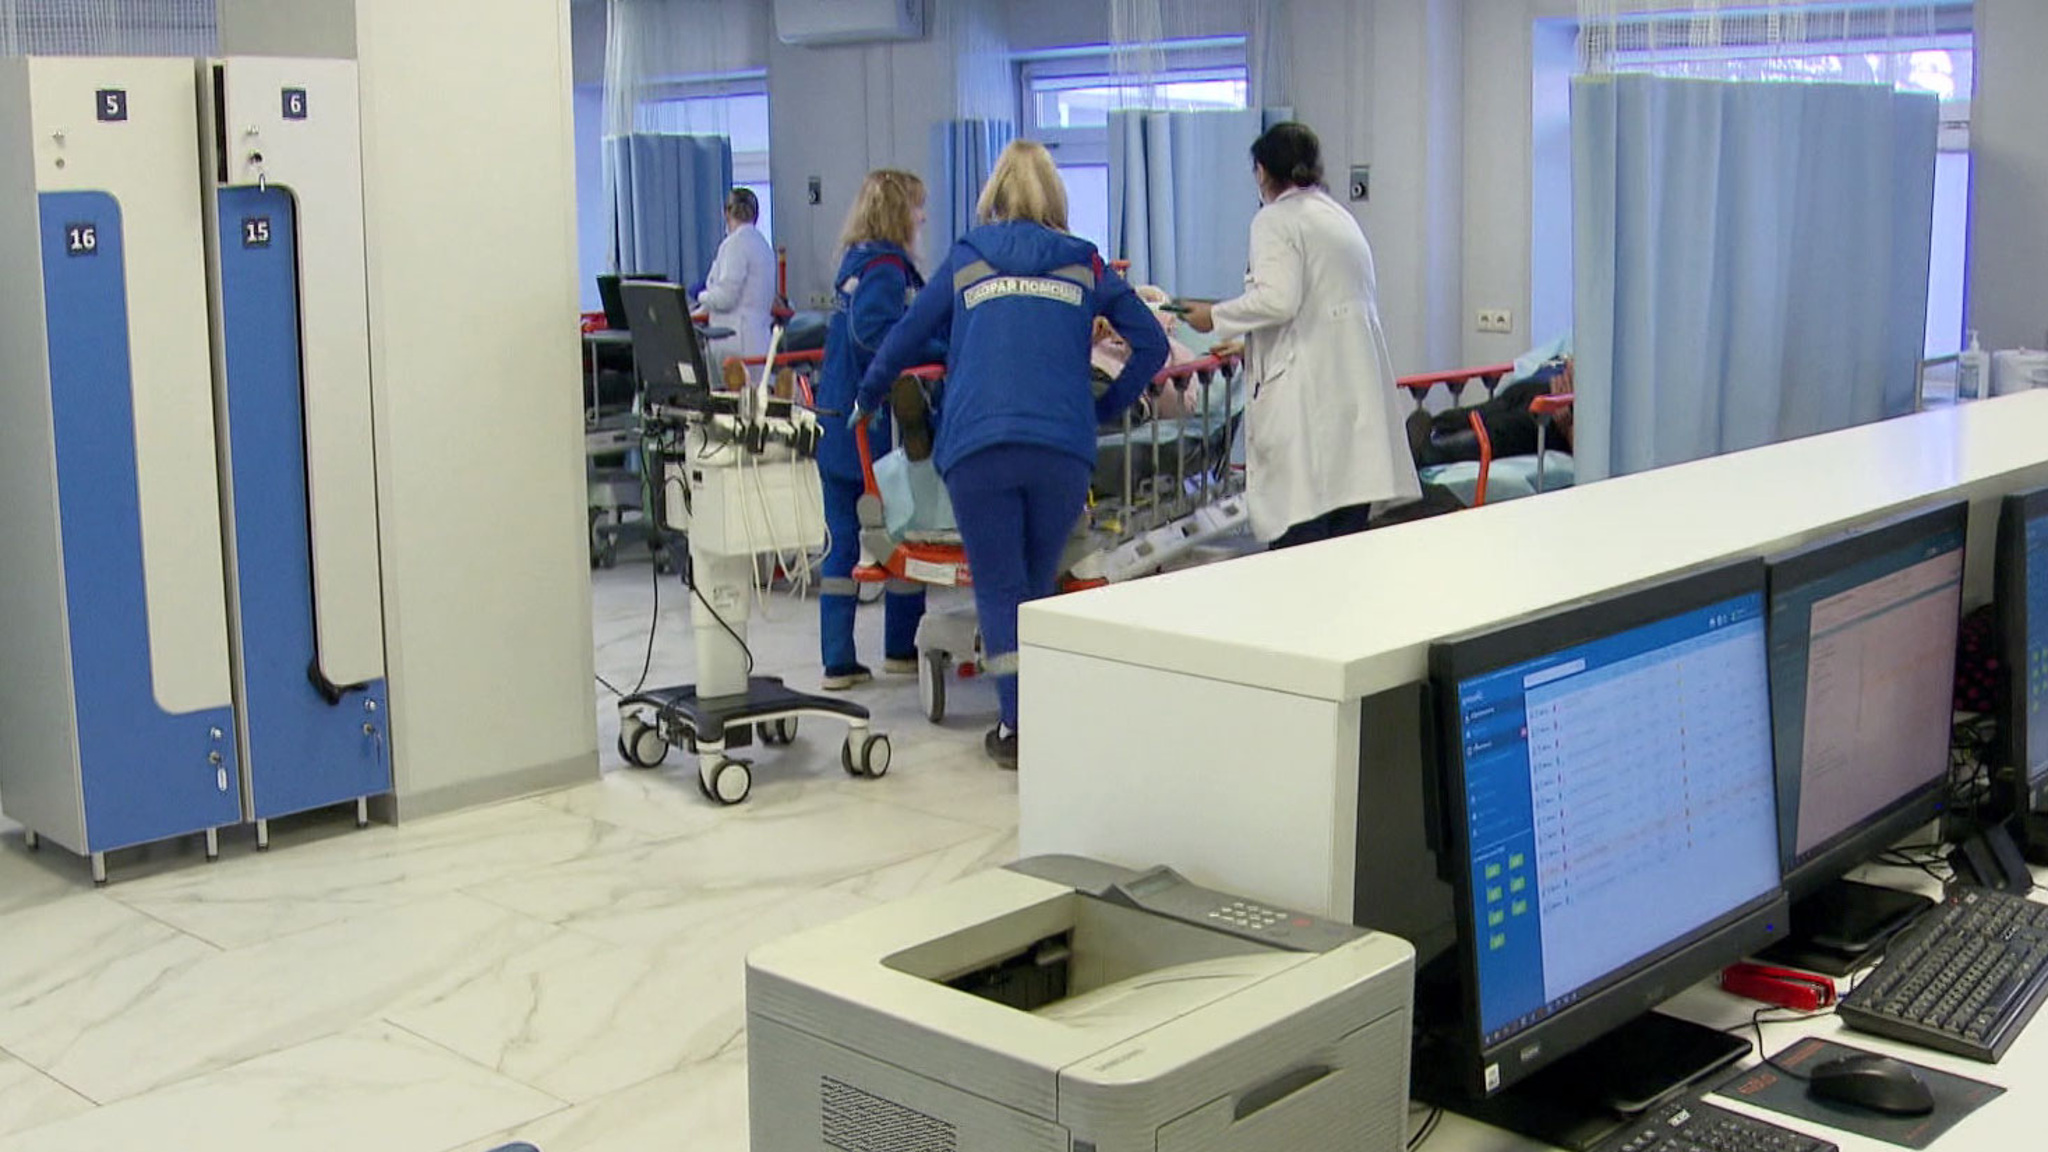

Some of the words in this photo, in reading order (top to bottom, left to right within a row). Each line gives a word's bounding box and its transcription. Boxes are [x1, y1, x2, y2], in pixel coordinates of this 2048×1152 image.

[106, 94, 119, 115] 5
[289, 94, 302, 114] 6
[69, 228, 97, 251] 16
[246, 221, 270, 243] 15
